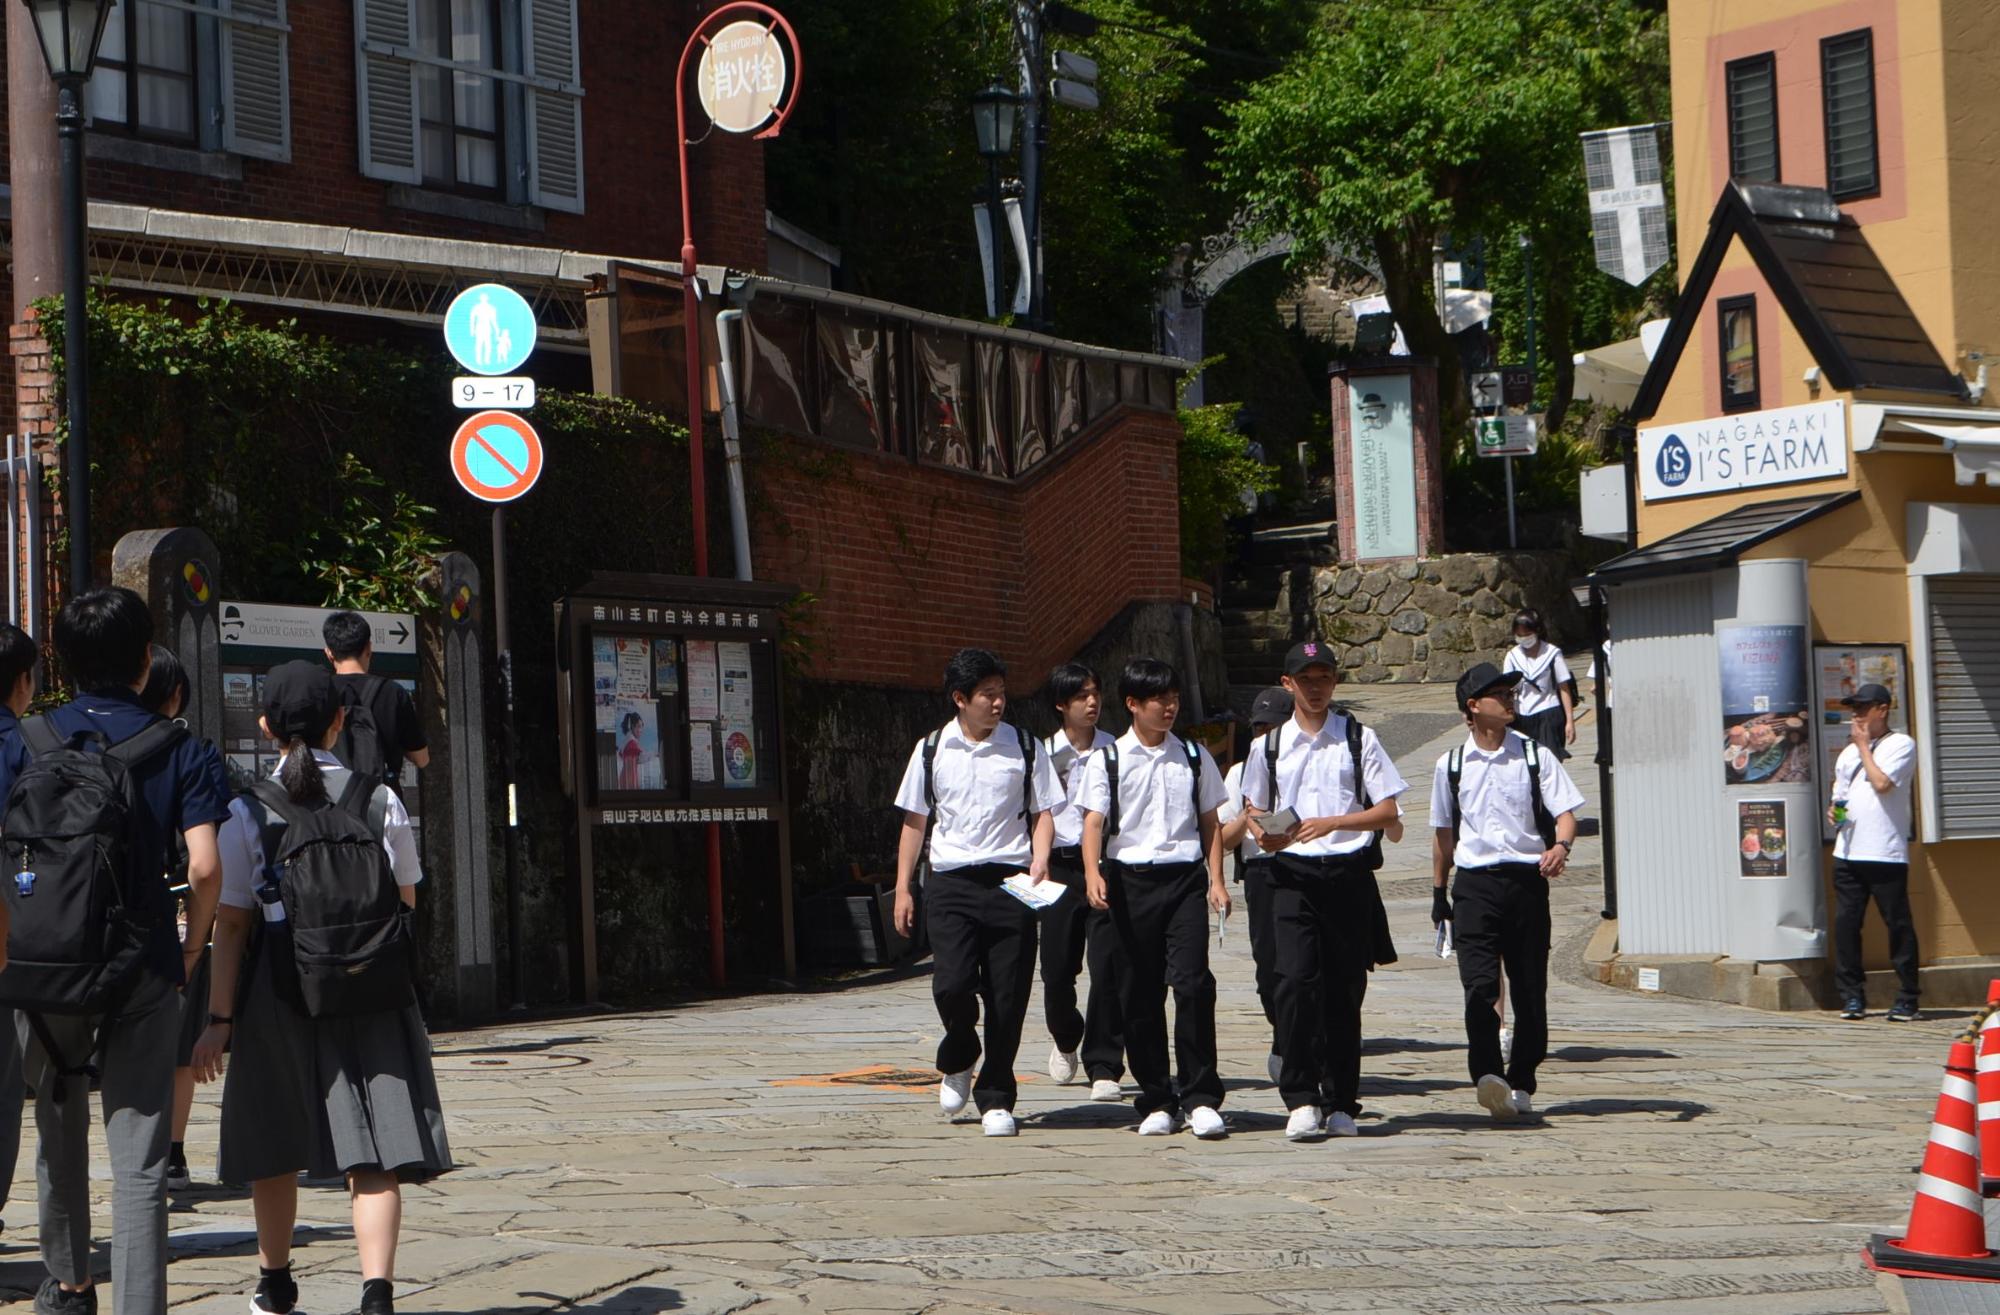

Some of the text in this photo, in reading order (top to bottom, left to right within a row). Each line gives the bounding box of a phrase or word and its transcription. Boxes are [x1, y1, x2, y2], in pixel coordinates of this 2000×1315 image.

[709, 51, 777, 100] 消火栓
[1697, 413, 1828, 447] NAGASAKI
[1663, 446, 1685, 473] I'S
[1699, 434, 1829, 482] I'S FARM
[1664, 472, 1685, 483] FARM
[249, 624, 316, 639] GLOVER GARDEN
